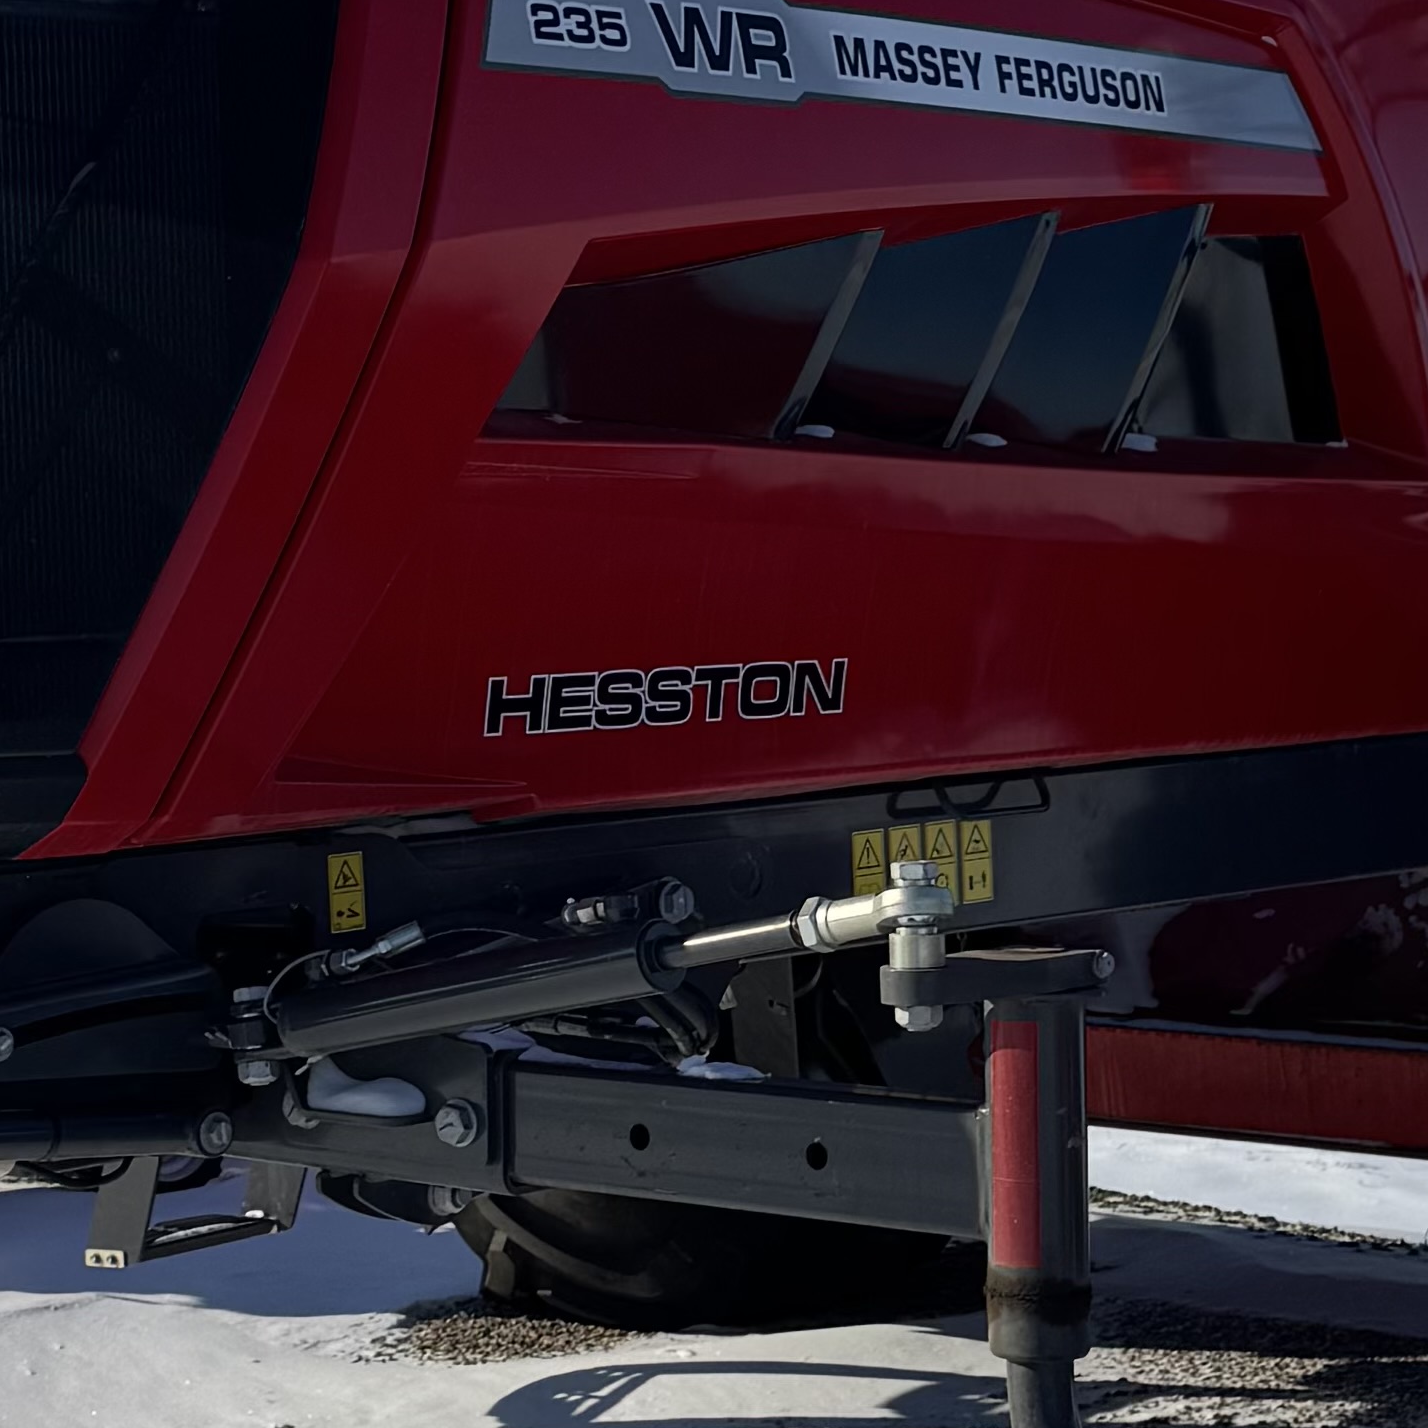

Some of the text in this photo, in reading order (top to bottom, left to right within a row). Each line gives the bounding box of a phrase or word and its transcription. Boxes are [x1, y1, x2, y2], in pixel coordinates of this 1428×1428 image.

[528, 0, 630, 52] 235
[832, 32, 983, 94] MASSEY
[996, 52, 1167, 115] FERGUSON
[483, 657, 848, 738] HESSTON
